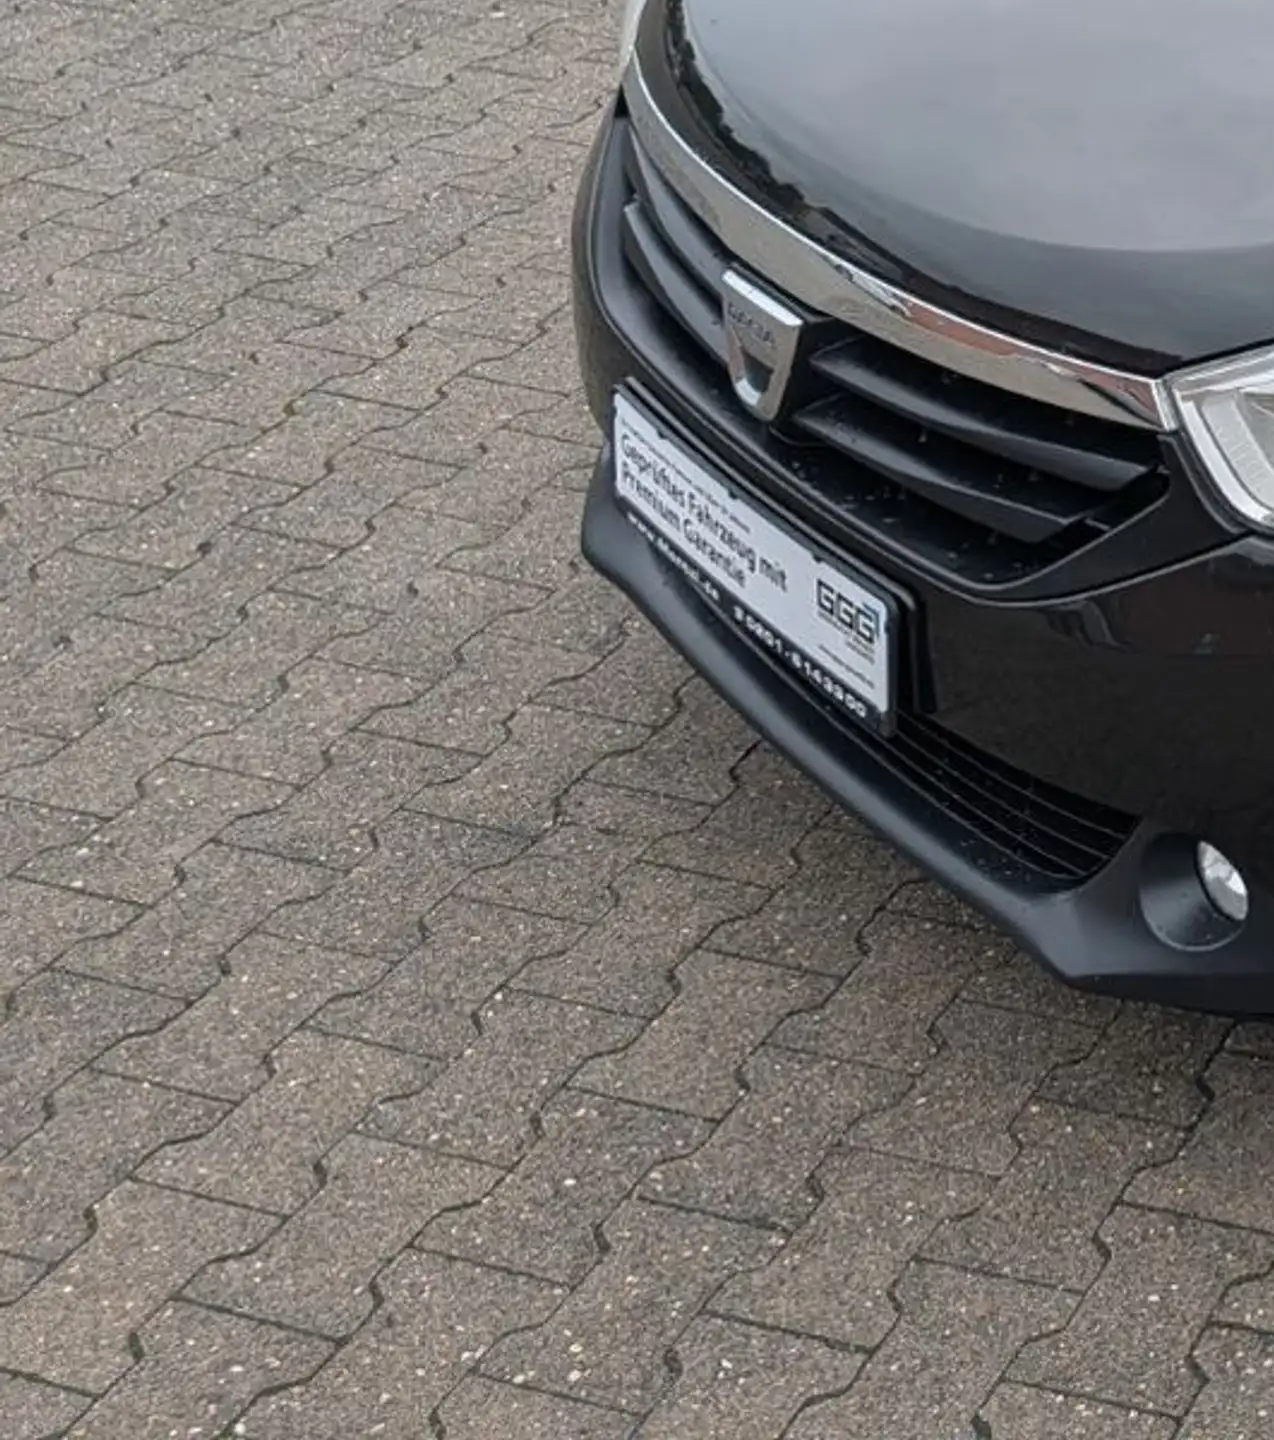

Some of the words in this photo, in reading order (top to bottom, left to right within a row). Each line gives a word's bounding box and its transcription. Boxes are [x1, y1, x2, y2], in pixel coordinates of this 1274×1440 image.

[621, 460, 682, 532] Premium
[682, 516, 746, 589] Garantie
[687, 490, 757, 575] Fahrzeug
[758, 555, 788, 594] mit
[816, 578, 876, 645] GGG
